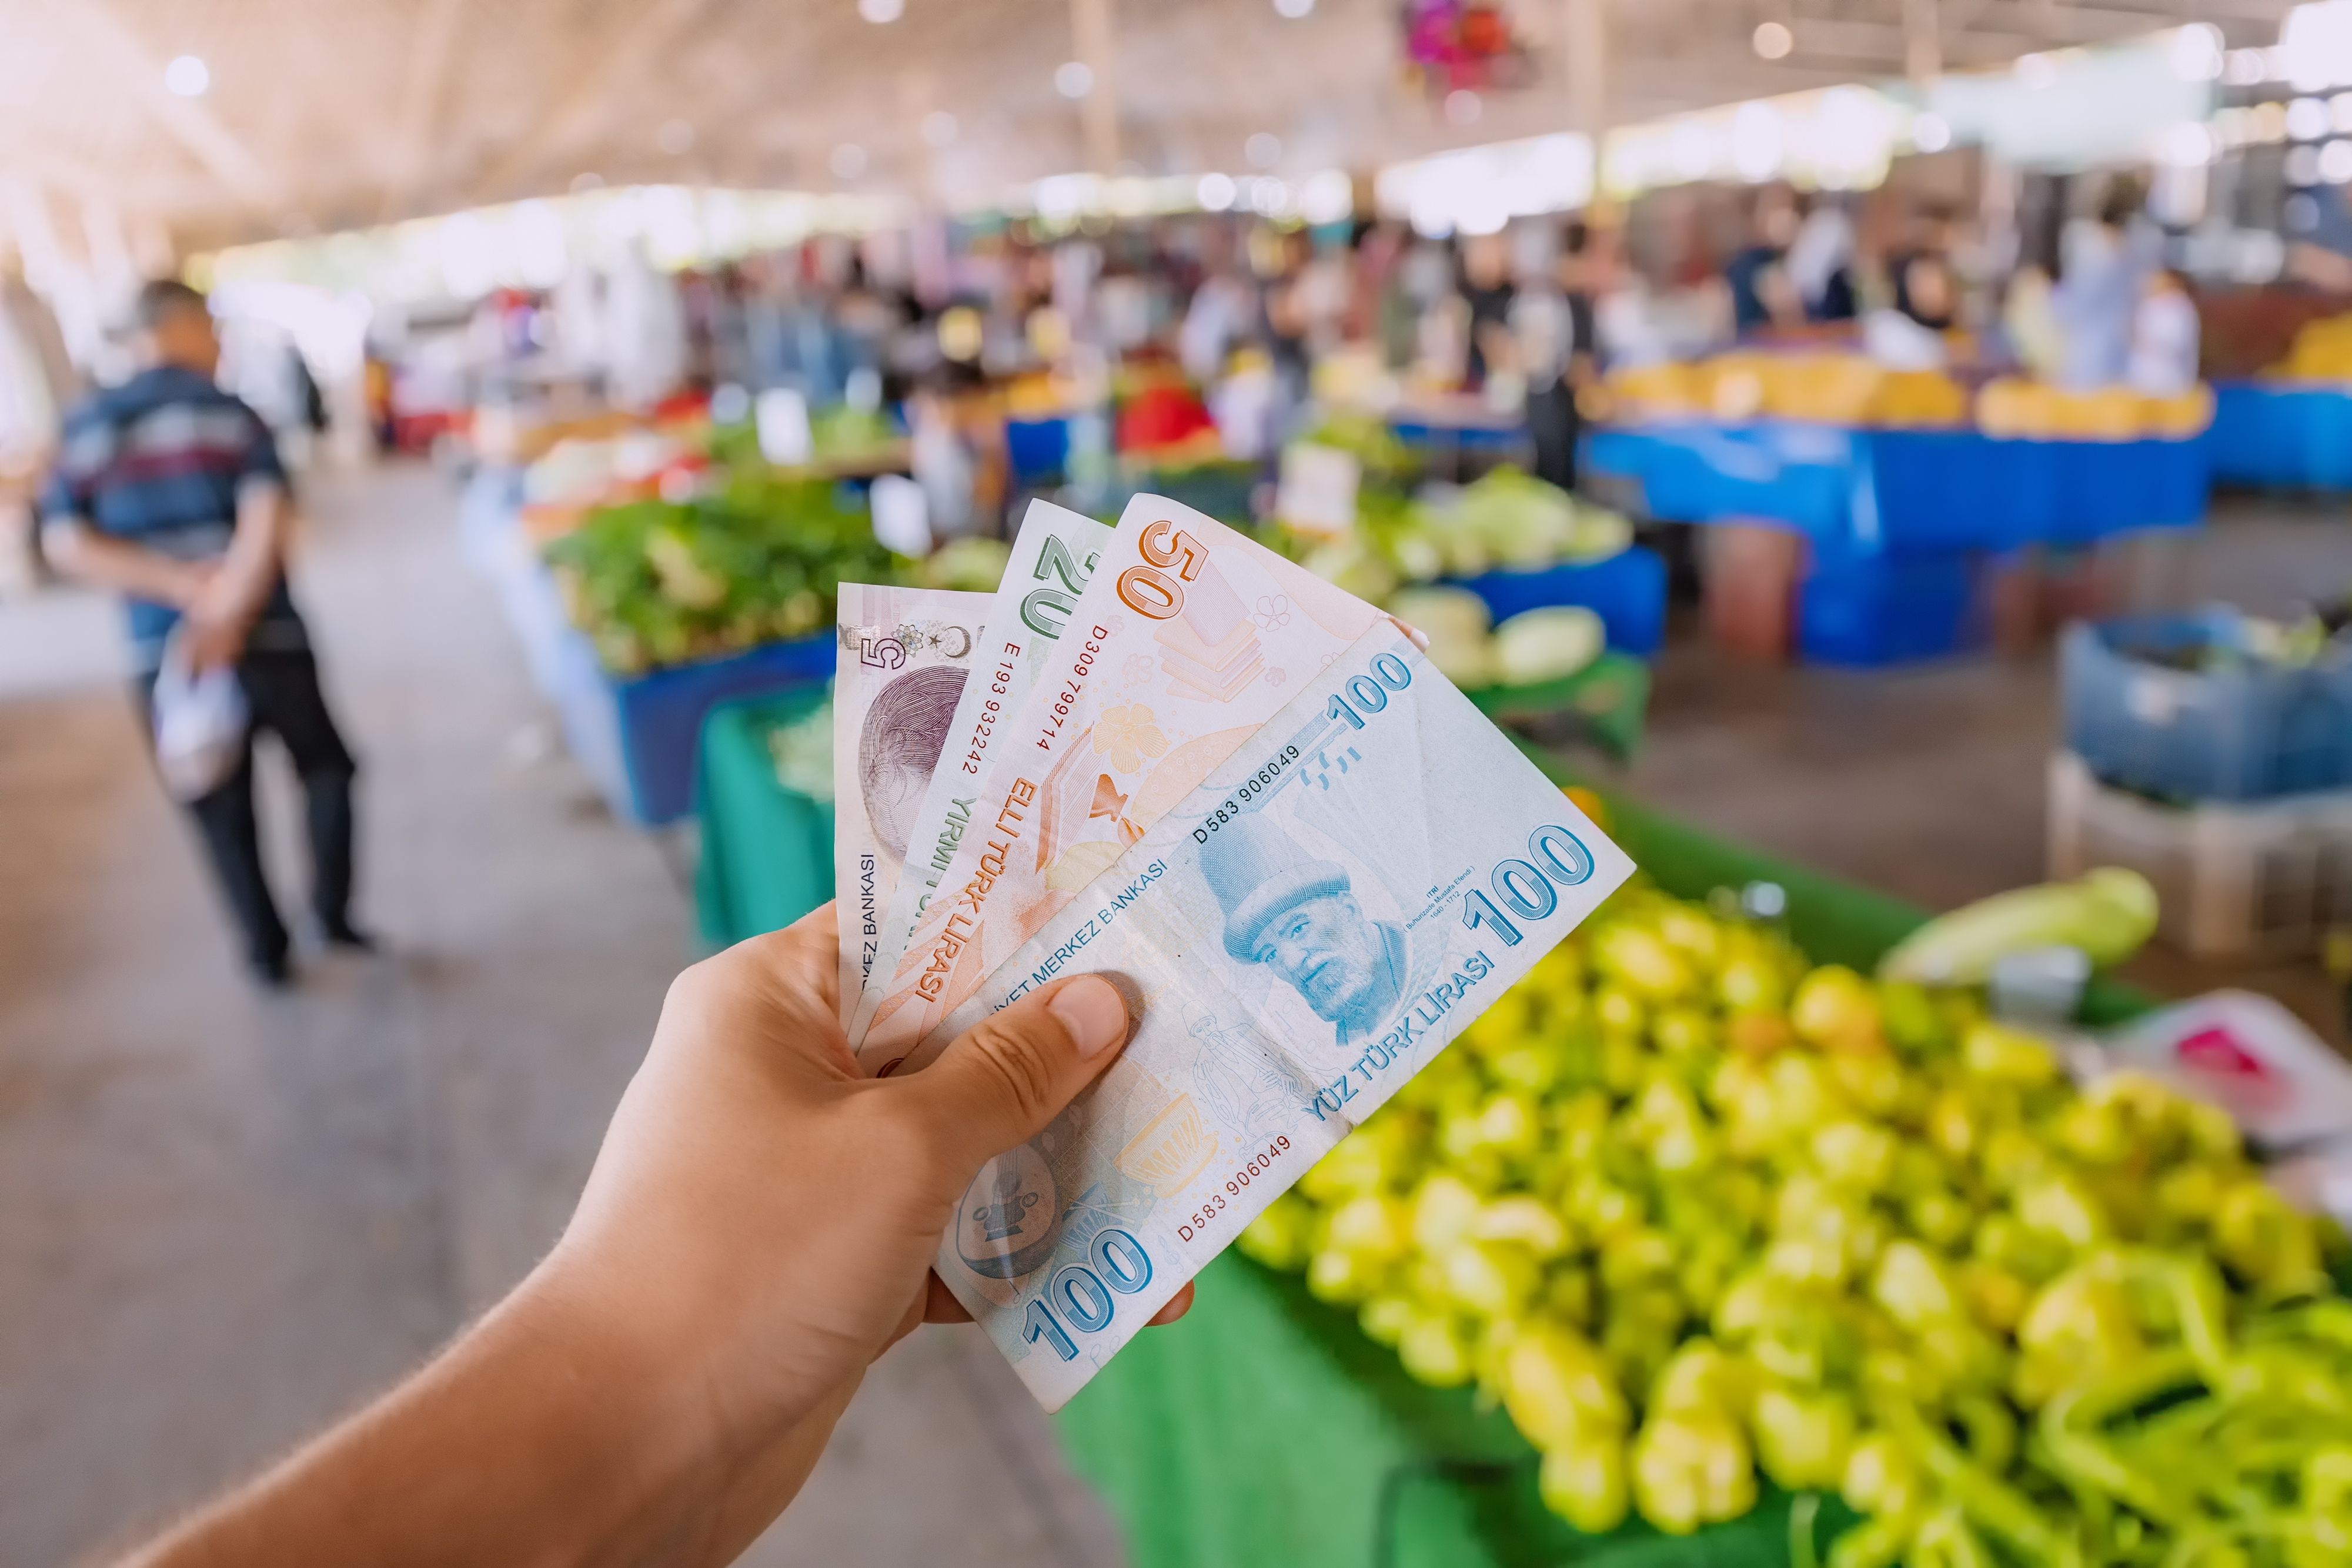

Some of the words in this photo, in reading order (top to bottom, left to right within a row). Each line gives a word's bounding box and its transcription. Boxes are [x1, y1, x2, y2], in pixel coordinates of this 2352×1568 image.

[1020, 534, 1101, 640] 20
[1117, 520, 1209, 620] 50
[860, 637, 906, 670] 5
[1037, 680, 1082, 751] 799714
[1327, 653, 1412, 731] 100
[961, 700, 1001, 774] 932242
[1238, 745, 1299, 802] 906049
[861, 854, 877, 935] BANKASI
[958, 841, 1011, 914] TÜRK
[1431, 906, 1444, 919] 1640
[1446, 891, 1461, 904] 1712
[1434, 884, 1455, 904] Mustafa
[1454, 868, 1472, 885] Efendi
[1462, 824, 1595, 947] 100
[1031, 920, 1101, 985] MERKEZ
[1097, 858, 1168, 925] BANKASI
[1301, 1075, 1359, 1122] YÜZ
[1349, 1015, 1424, 1082] TÜRK
[1226, 1135, 1291, 1195] 906049
[1023, 1229, 1153, 1362] 100
